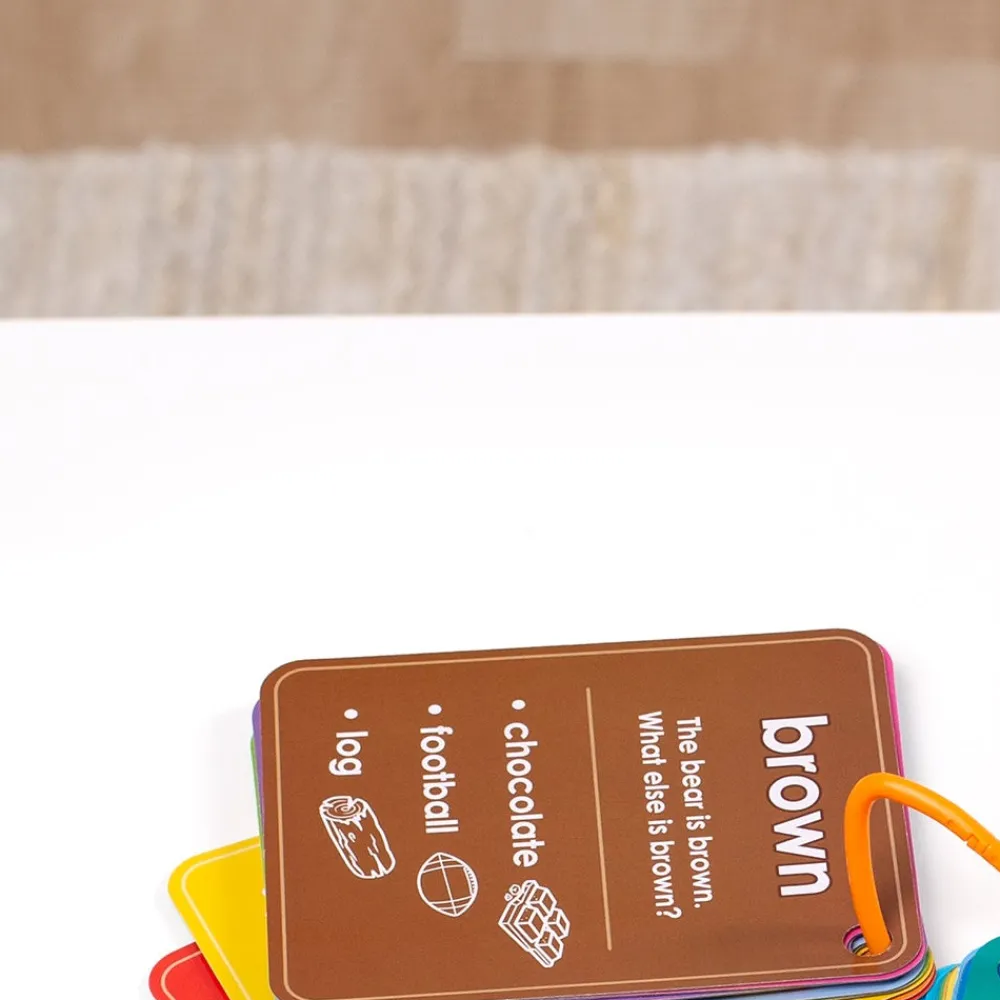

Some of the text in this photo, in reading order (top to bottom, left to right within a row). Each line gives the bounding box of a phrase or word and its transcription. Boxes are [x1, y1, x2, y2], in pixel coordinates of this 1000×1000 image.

[328, 730, 369, 776] log
[418, 725, 459, 834] football
[503, 722, 546, 868] chocolate
[638, 710, 683, 919] What else is brown?
[676, 716, 714, 909] The bear is brown.
[760, 714, 832, 897] brown
